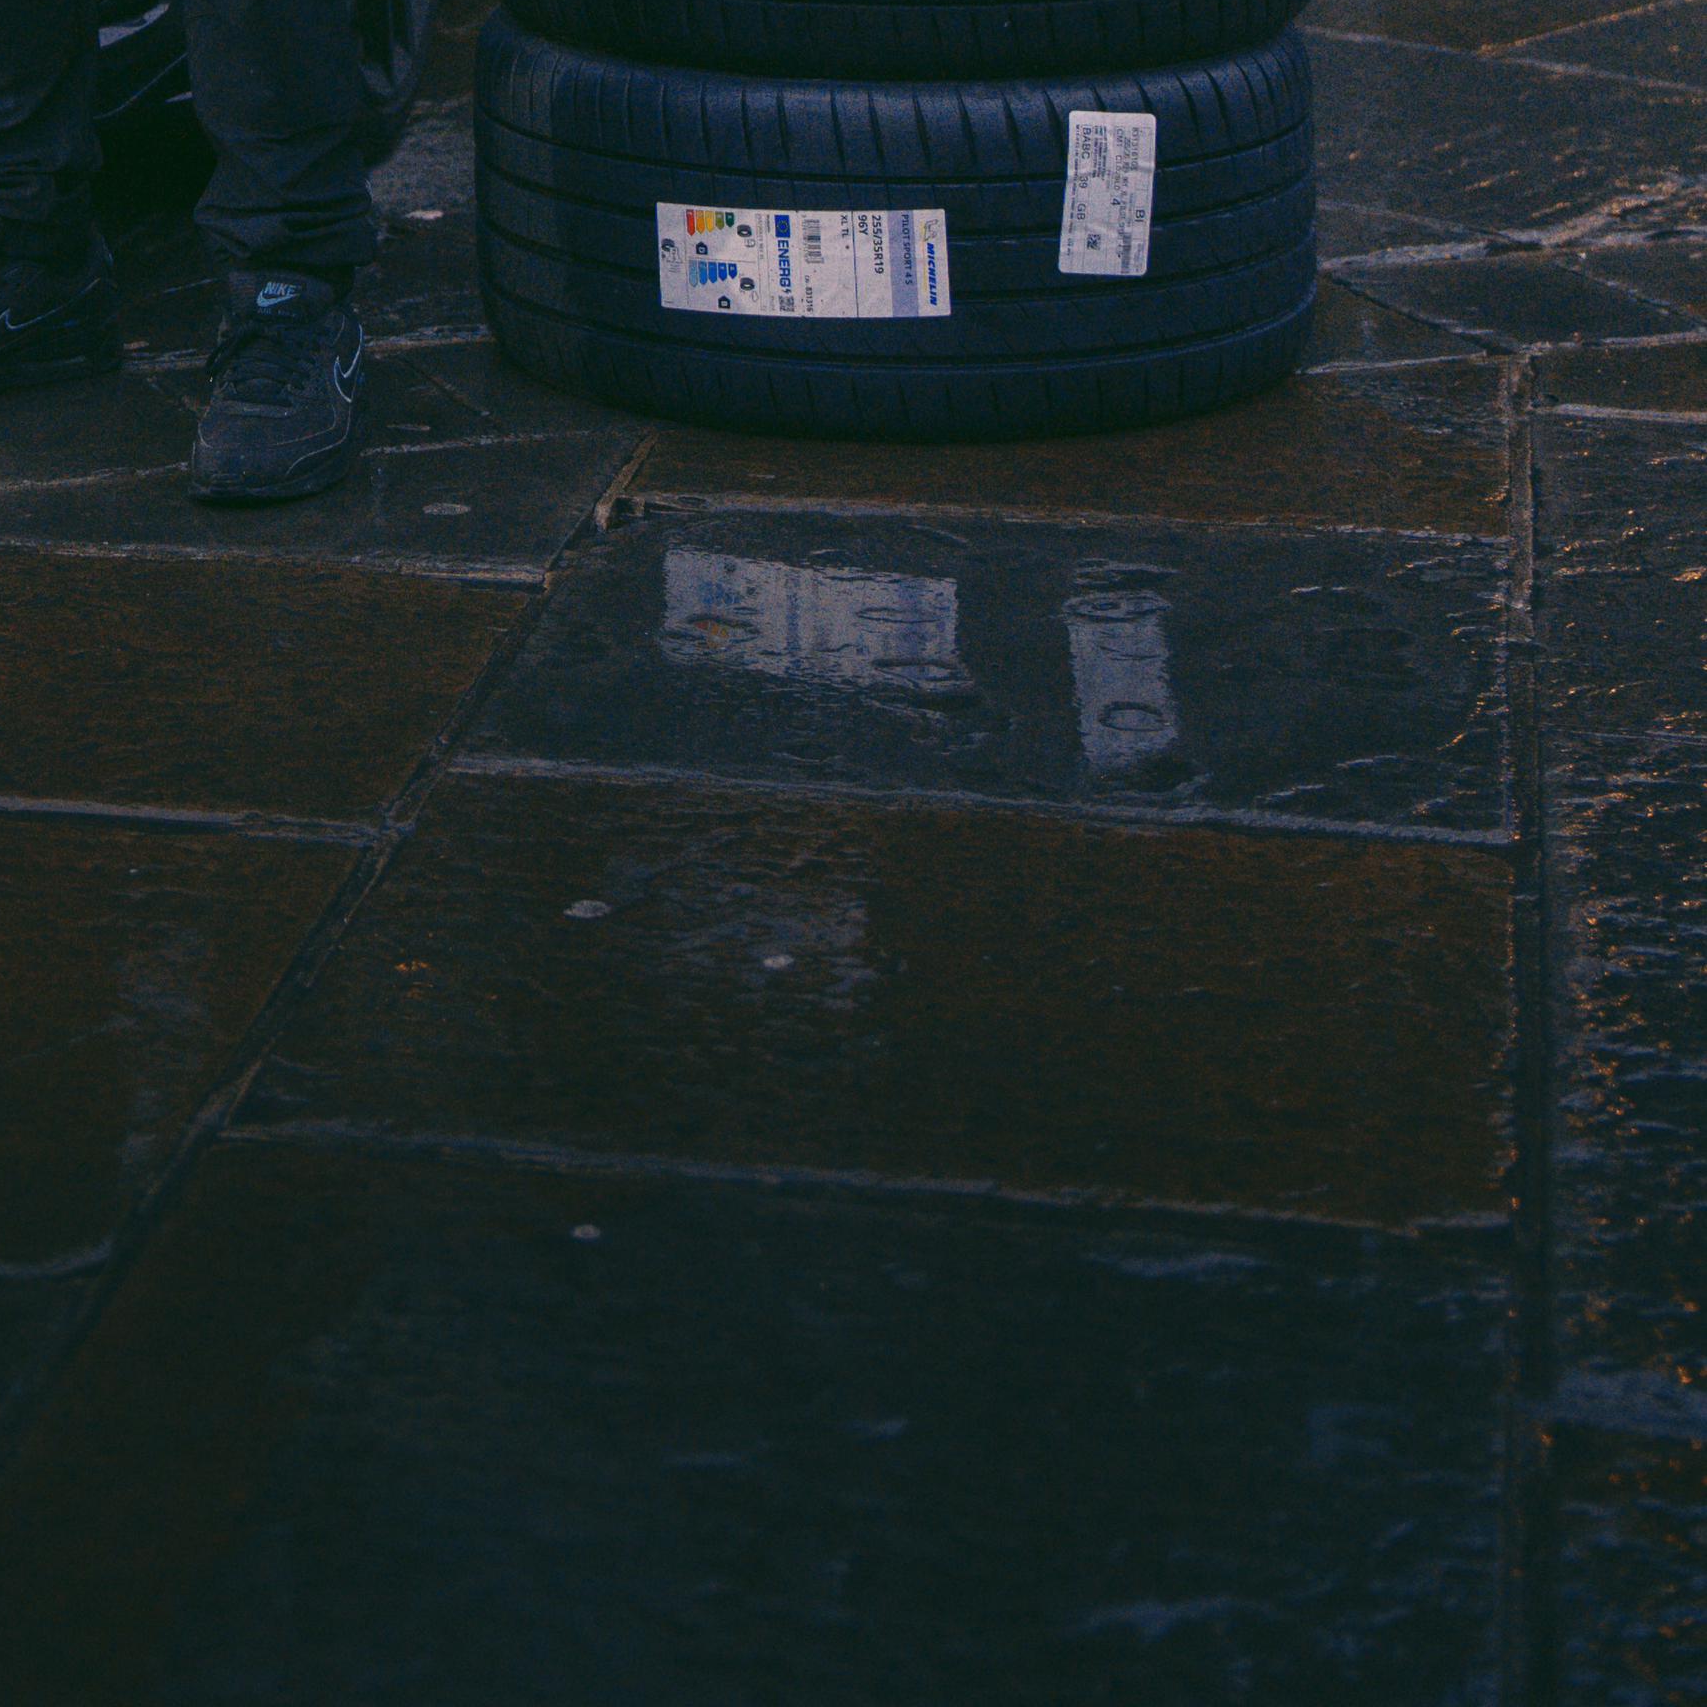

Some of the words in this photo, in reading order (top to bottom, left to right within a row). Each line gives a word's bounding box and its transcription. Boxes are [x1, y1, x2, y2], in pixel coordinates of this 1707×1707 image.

[1081, 127, 1091, 159] BABC
[1079, 176, 1089, 189] 39
[1076, 203, 1085, 220] GB
[1110, 198, 1120, 206] 4
[841, 215, 848, 226] XL
[858, 214, 868, 236] 96Y
[901, 214, 909, 238] PILOT
[842, 228, 849, 238] TL
[872, 214, 884, 274] 255/35R19
[777, 240, 791, 288] ENERG
[903, 242, 911, 271] SPORT
[927, 242, 937, 306] MICHELIN
[264, 281, 297, 296] NIKE
